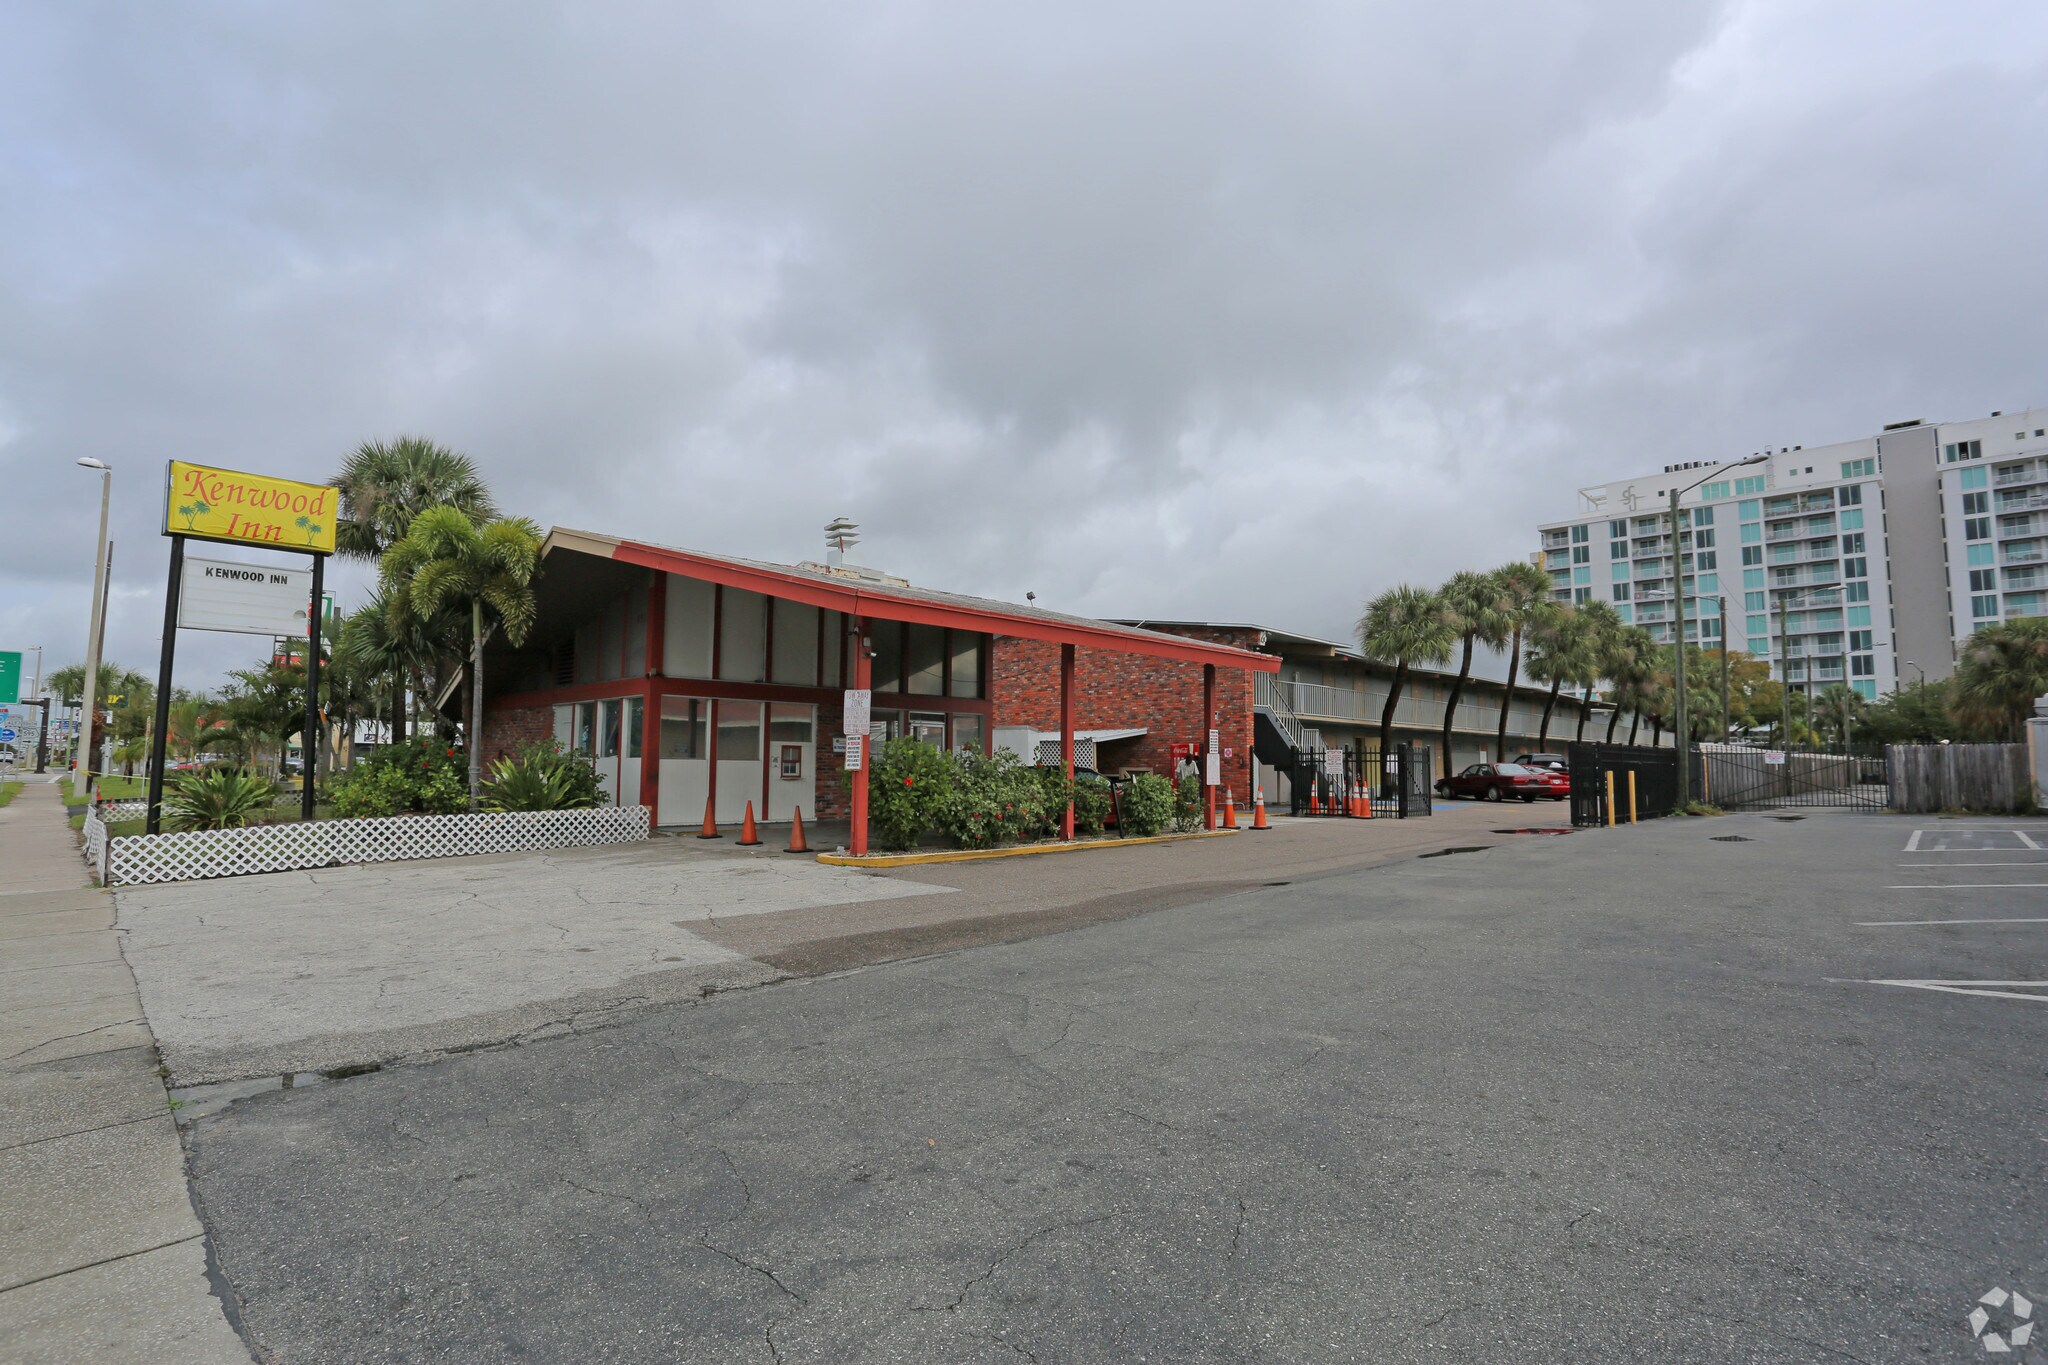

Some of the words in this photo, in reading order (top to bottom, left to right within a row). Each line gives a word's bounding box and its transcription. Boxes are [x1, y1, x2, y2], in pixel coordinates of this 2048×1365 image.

[183, 470, 332, 516] Kenwood
[224, 513, 284, 541] Inn
[205, 567, 265, 582] KENWOOD
[270, 574, 288, 585] INN
